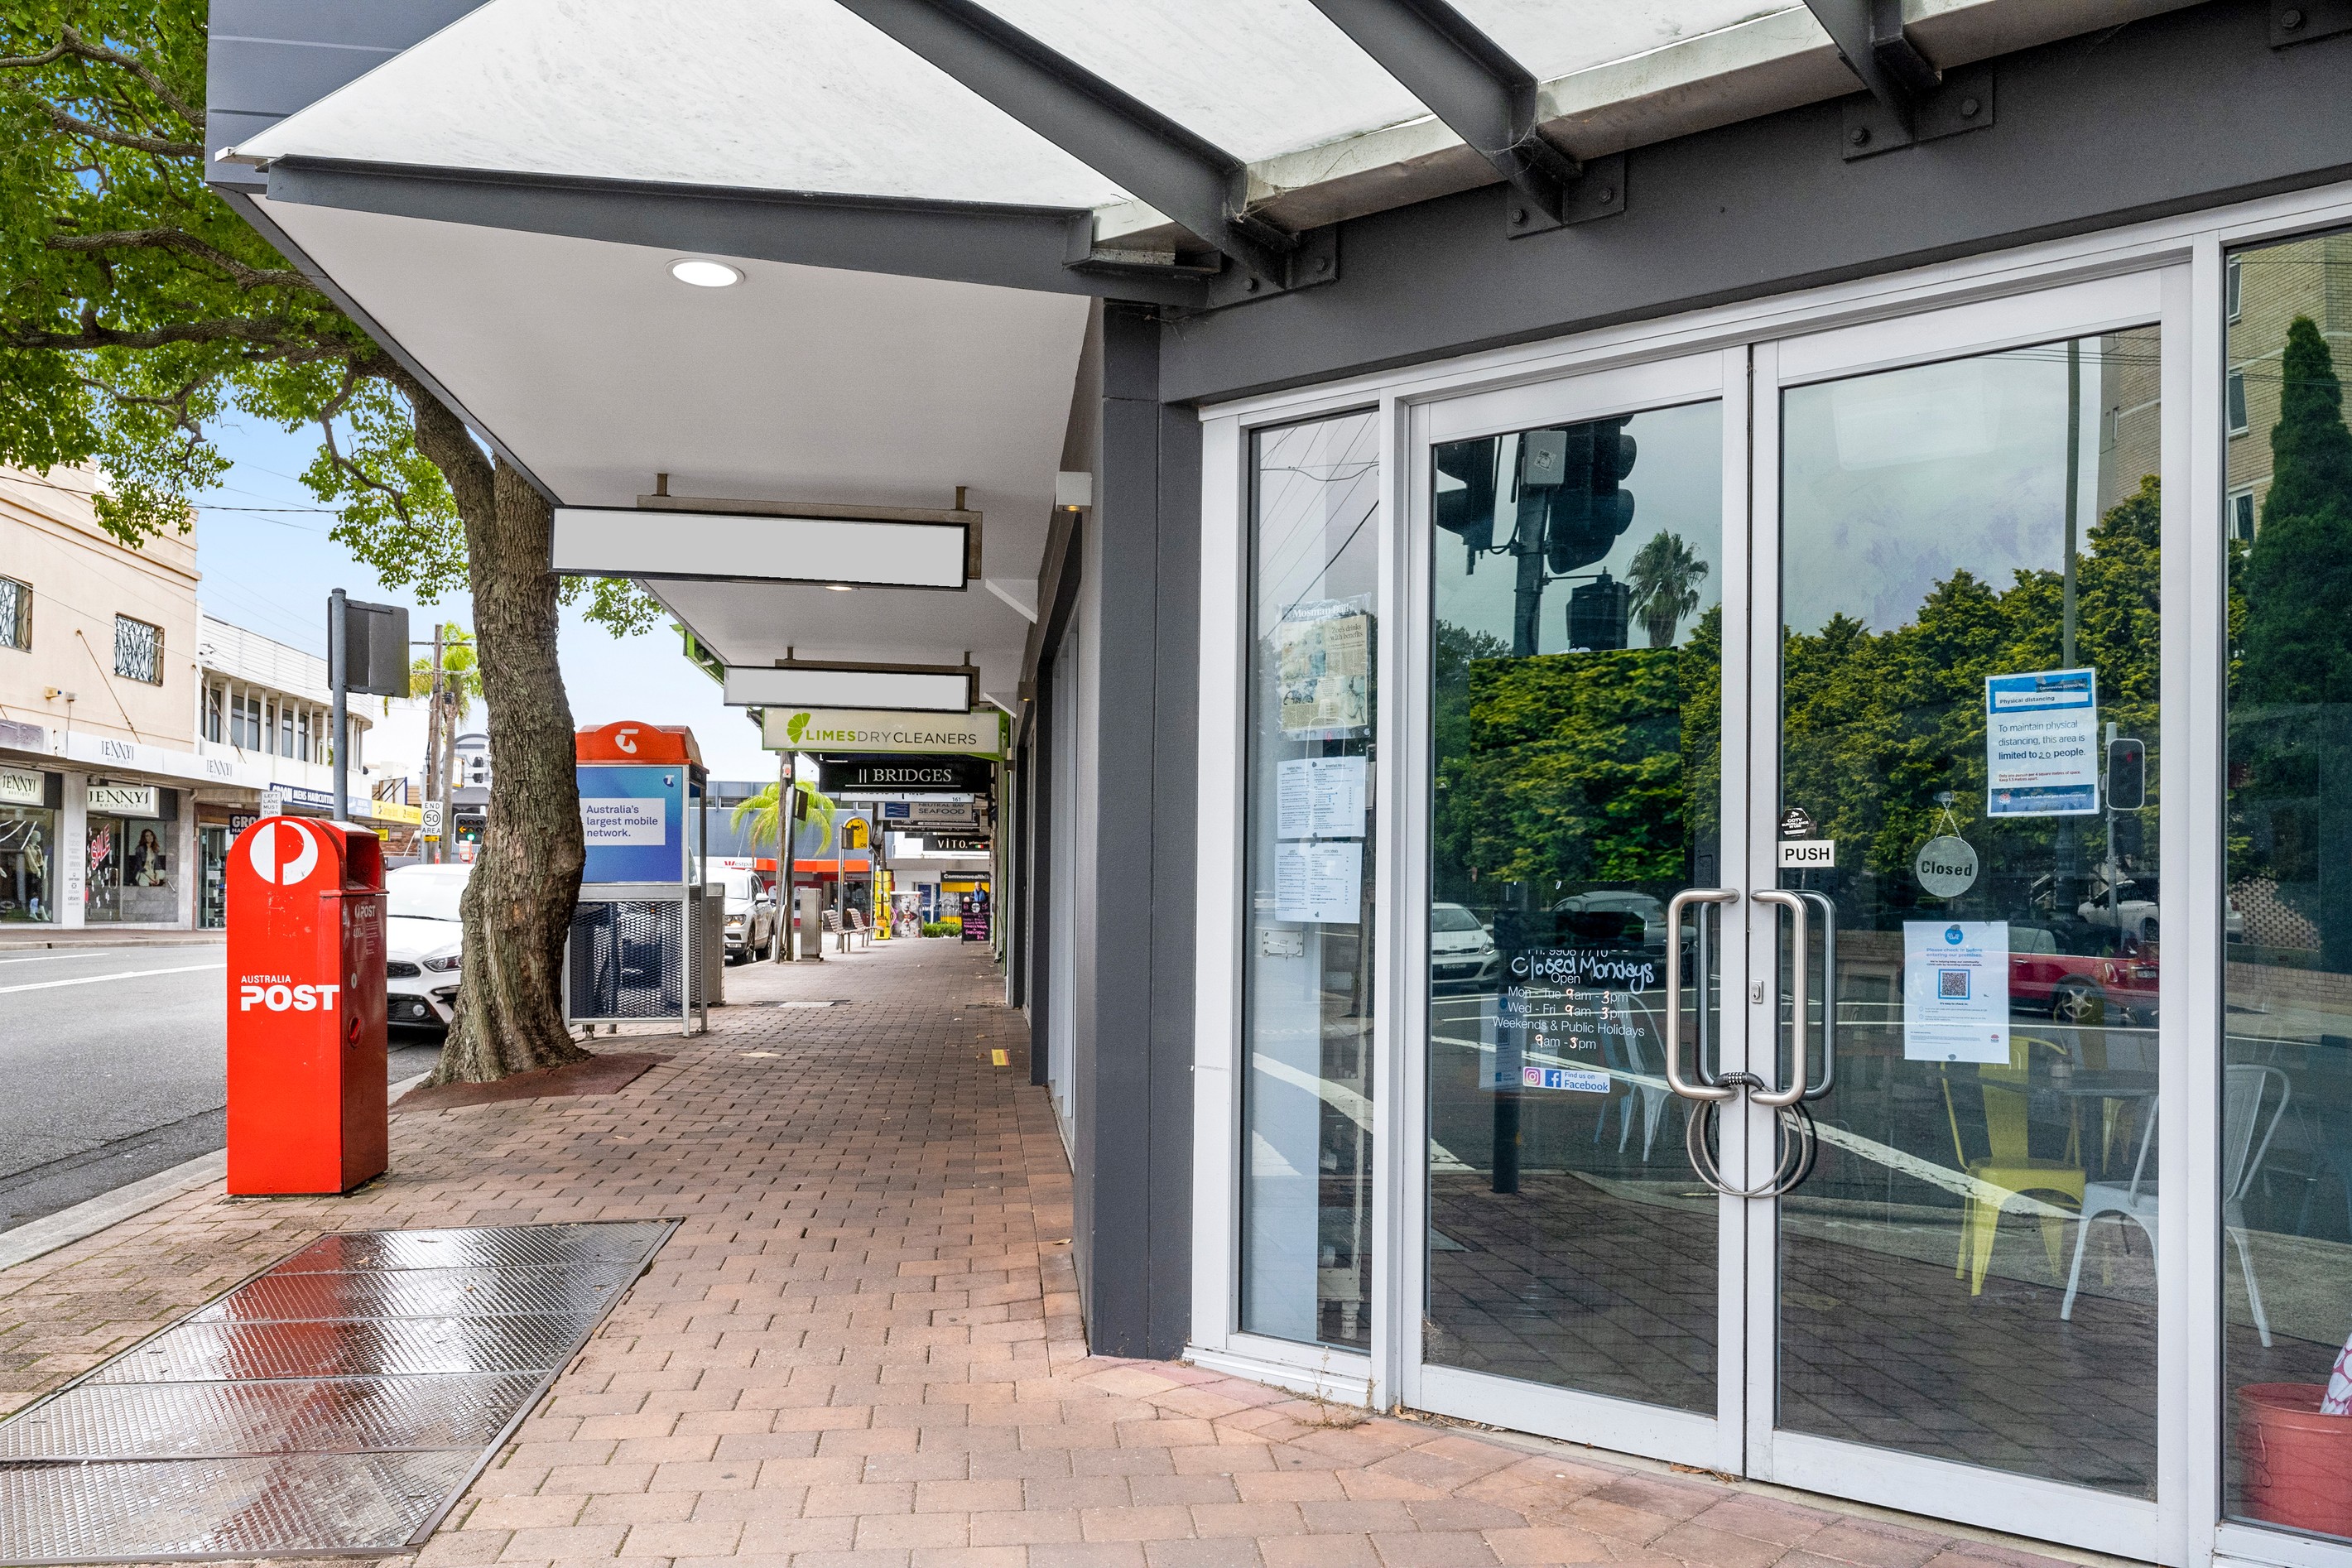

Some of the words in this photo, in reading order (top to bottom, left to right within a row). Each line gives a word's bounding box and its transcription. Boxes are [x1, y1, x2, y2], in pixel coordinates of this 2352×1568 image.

[1344, 631, 1364, 639] benefits
[1998, 724, 2008, 733] To
[2010, 723, 2044, 732] maintain
[2047, 720, 2078, 731] physical
[1998, 737, 2041, 747] distancing,
[2043, 735, 2057, 744] this
[2059, 735, 2076, 743] area
[2079, 733, 2085, 742] is
[1999, 751, 2027, 760] limited
[2054, 748, 2086, 758] people.
[873, 768, 952, 782] BRIDGES
[293, 787, 307, 801] MENS
[308, 791, 334, 805] HAIRCUTTIN
[586, 806, 639, 814] Australia's
[426, 814, 439, 824] 50
[587, 817, 622, 827] largest
[625, 817, 658, 825] mobile
[587, 829, 631, 837] network.
[91, 824, 111, 871] SALE
[1785, 848, 1830, 861] PUSH
[1922, 861, 1973, 877] Closed
[361, 906, 376, 918] POST
[241, 975, 291, 984] AUSTRALIA
[1512, 955, 1577, 981] Closed
[1580, 956, 1655, 995] Mondays
[1551, 973, 1580, 985] Open
[241, 984, 340, 1012] POST
[1508, 987, 1532, 997] Mon
[1542, 988, 1561, 998] Tue
[1566, 988, 1592, 1001] 9am
[1601, 991, 1628, 1004] 3pm
[1508, 1003, 1532, 1013] Wed
[1543, 1004, 1556, 1014] Fri
[1565, 1004, 1591, 1017] 9am
[1600, 1007, 1628, 1020] 3pm
[1493, 1017, 1547, 1031] Weekends
[1551, 1022, 1559, 1032] &
[1561, 1022, 1594, 1033] Public
[1598, 1023, 1645, 1039] Holidays
[1535, 1034, 1561, 1048] 9am
[1570, 1037, 1596, 1051] 3pm
[1565, 1080, 1609, 1091] Facebook
